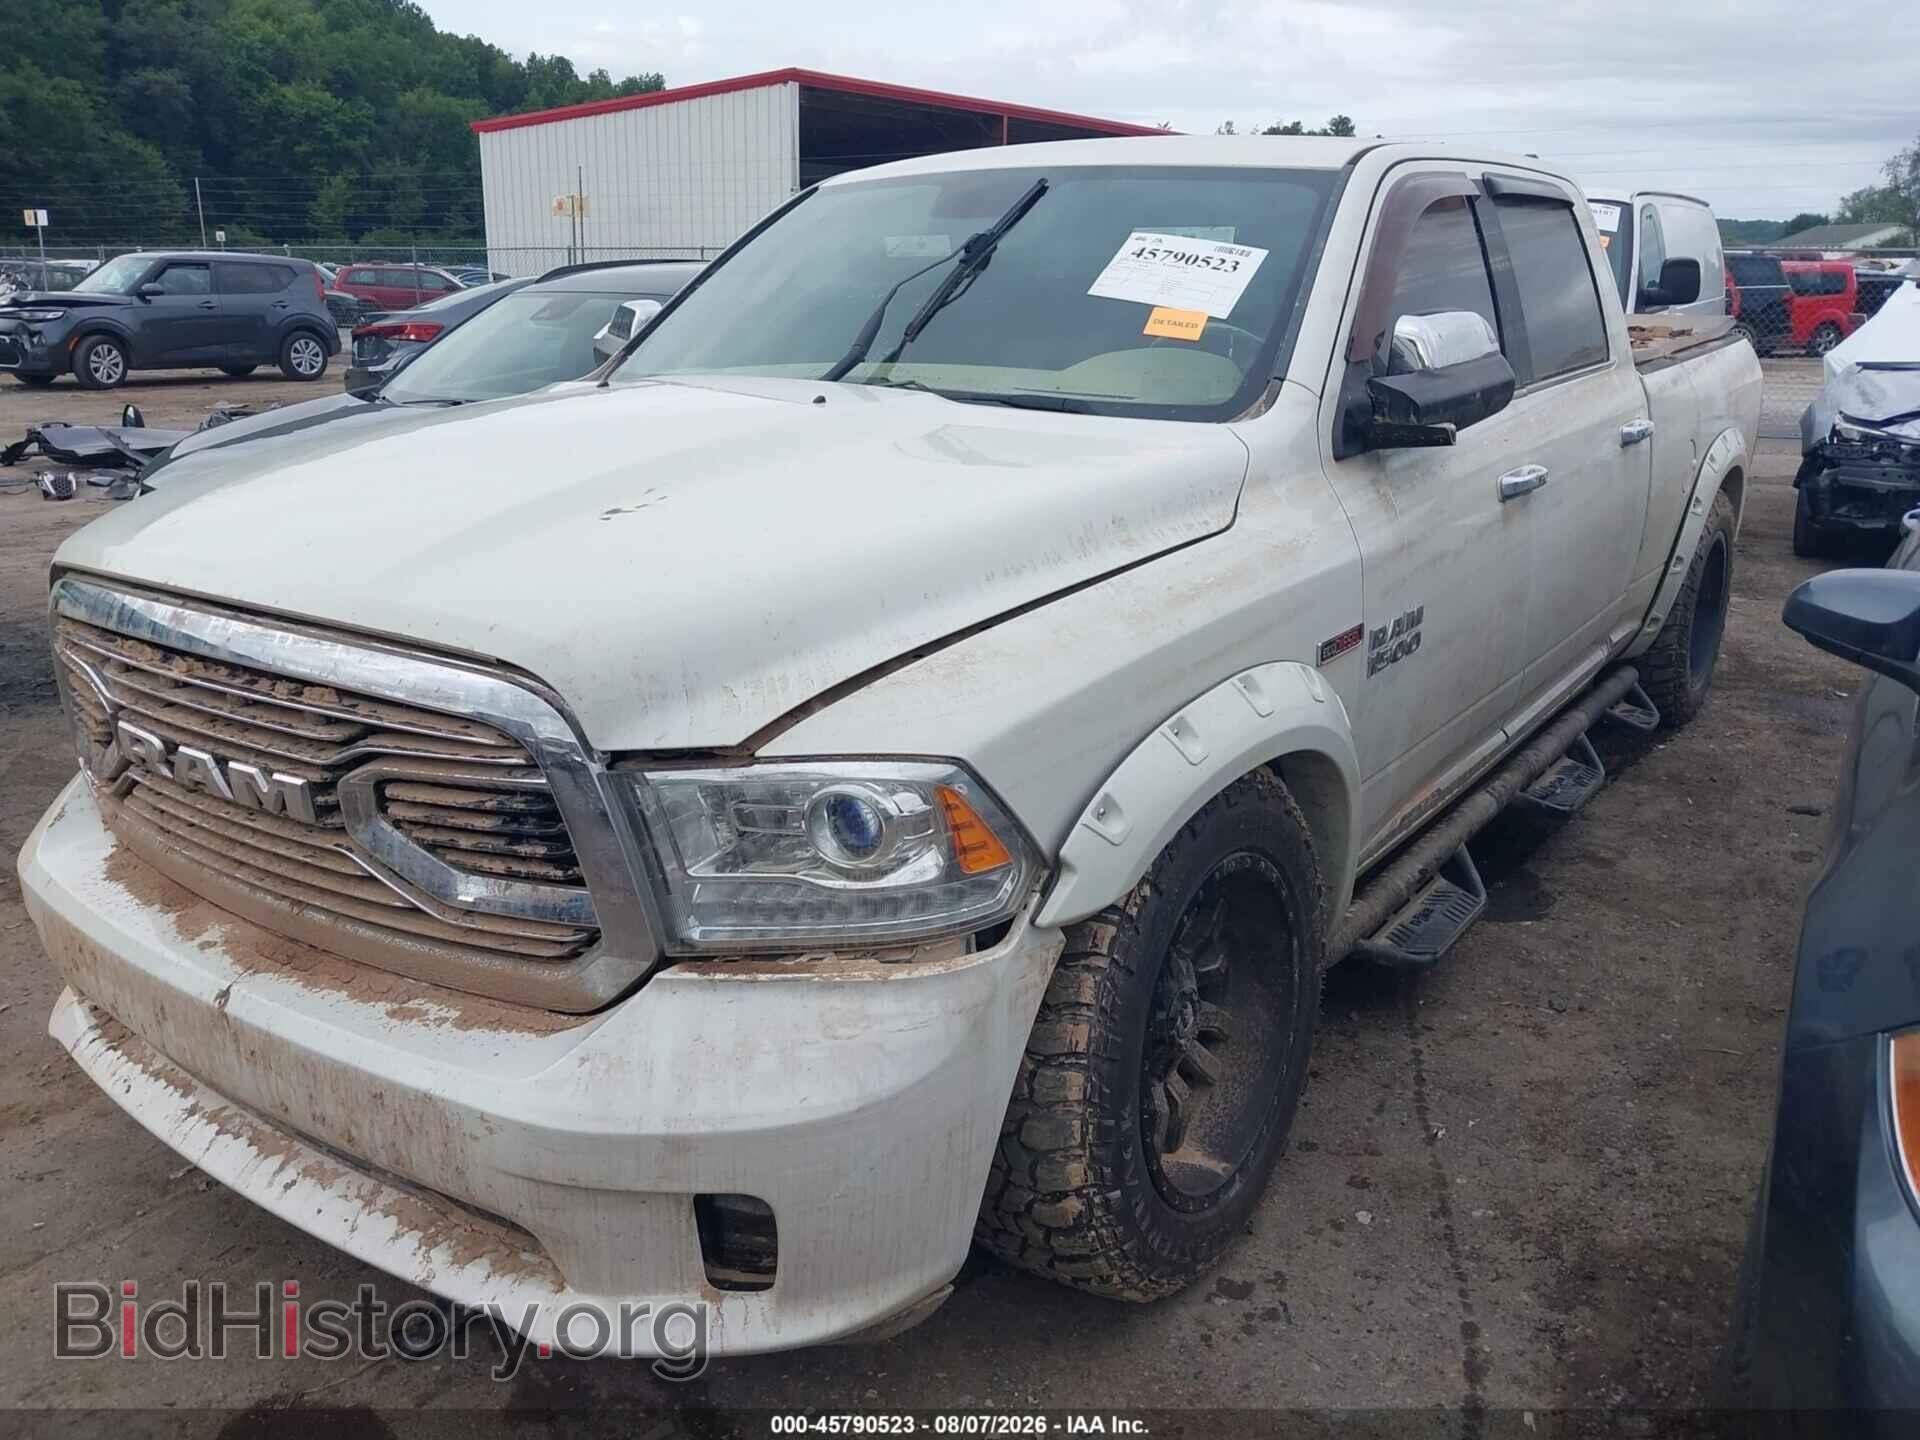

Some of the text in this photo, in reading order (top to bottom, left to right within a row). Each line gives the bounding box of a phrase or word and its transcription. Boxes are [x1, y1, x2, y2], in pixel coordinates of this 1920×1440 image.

[1131, 246, 1241, 274] 45790523
[1152, 318, 1199, 330] DETAILED
[1368, 604, 1424, 651] RAM
[1366, 630, 1422, 680] 1500
[117, 719, 317, 826] RAM
